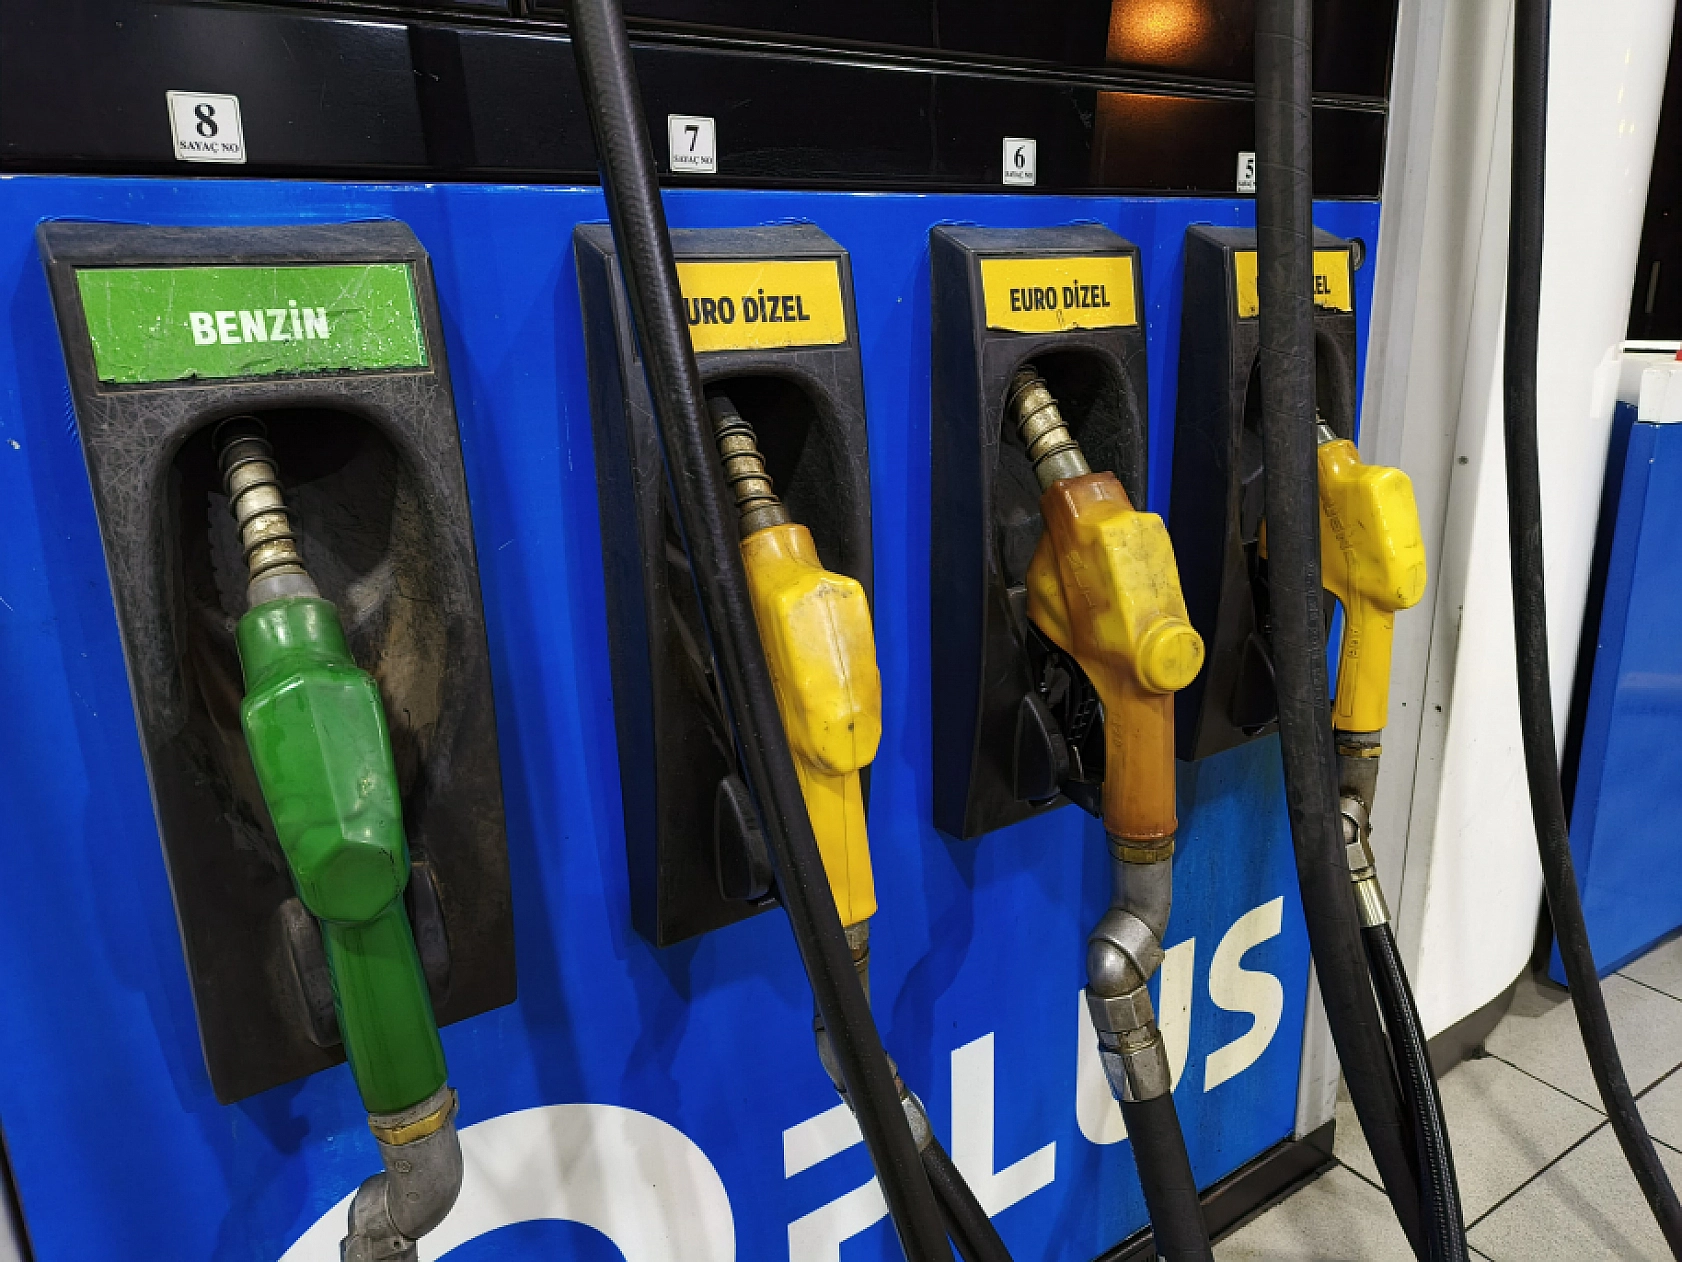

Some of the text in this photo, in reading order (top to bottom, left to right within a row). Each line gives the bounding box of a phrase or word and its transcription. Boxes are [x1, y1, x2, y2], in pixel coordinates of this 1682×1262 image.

[194, 103, 219, 138] 8
[180, 140, 239, 153] SAYAÇ NO
[684, 125, 700, 151] 7
[1013, 145, 1026, 169] 6
[1245, 158, 1254, 179] 5
[682, 288, 811, 326] URO DİZEL
[1009, 278, 1111, 312] EURO DİZEL
[189, 299, 330, 346] BENZİN
